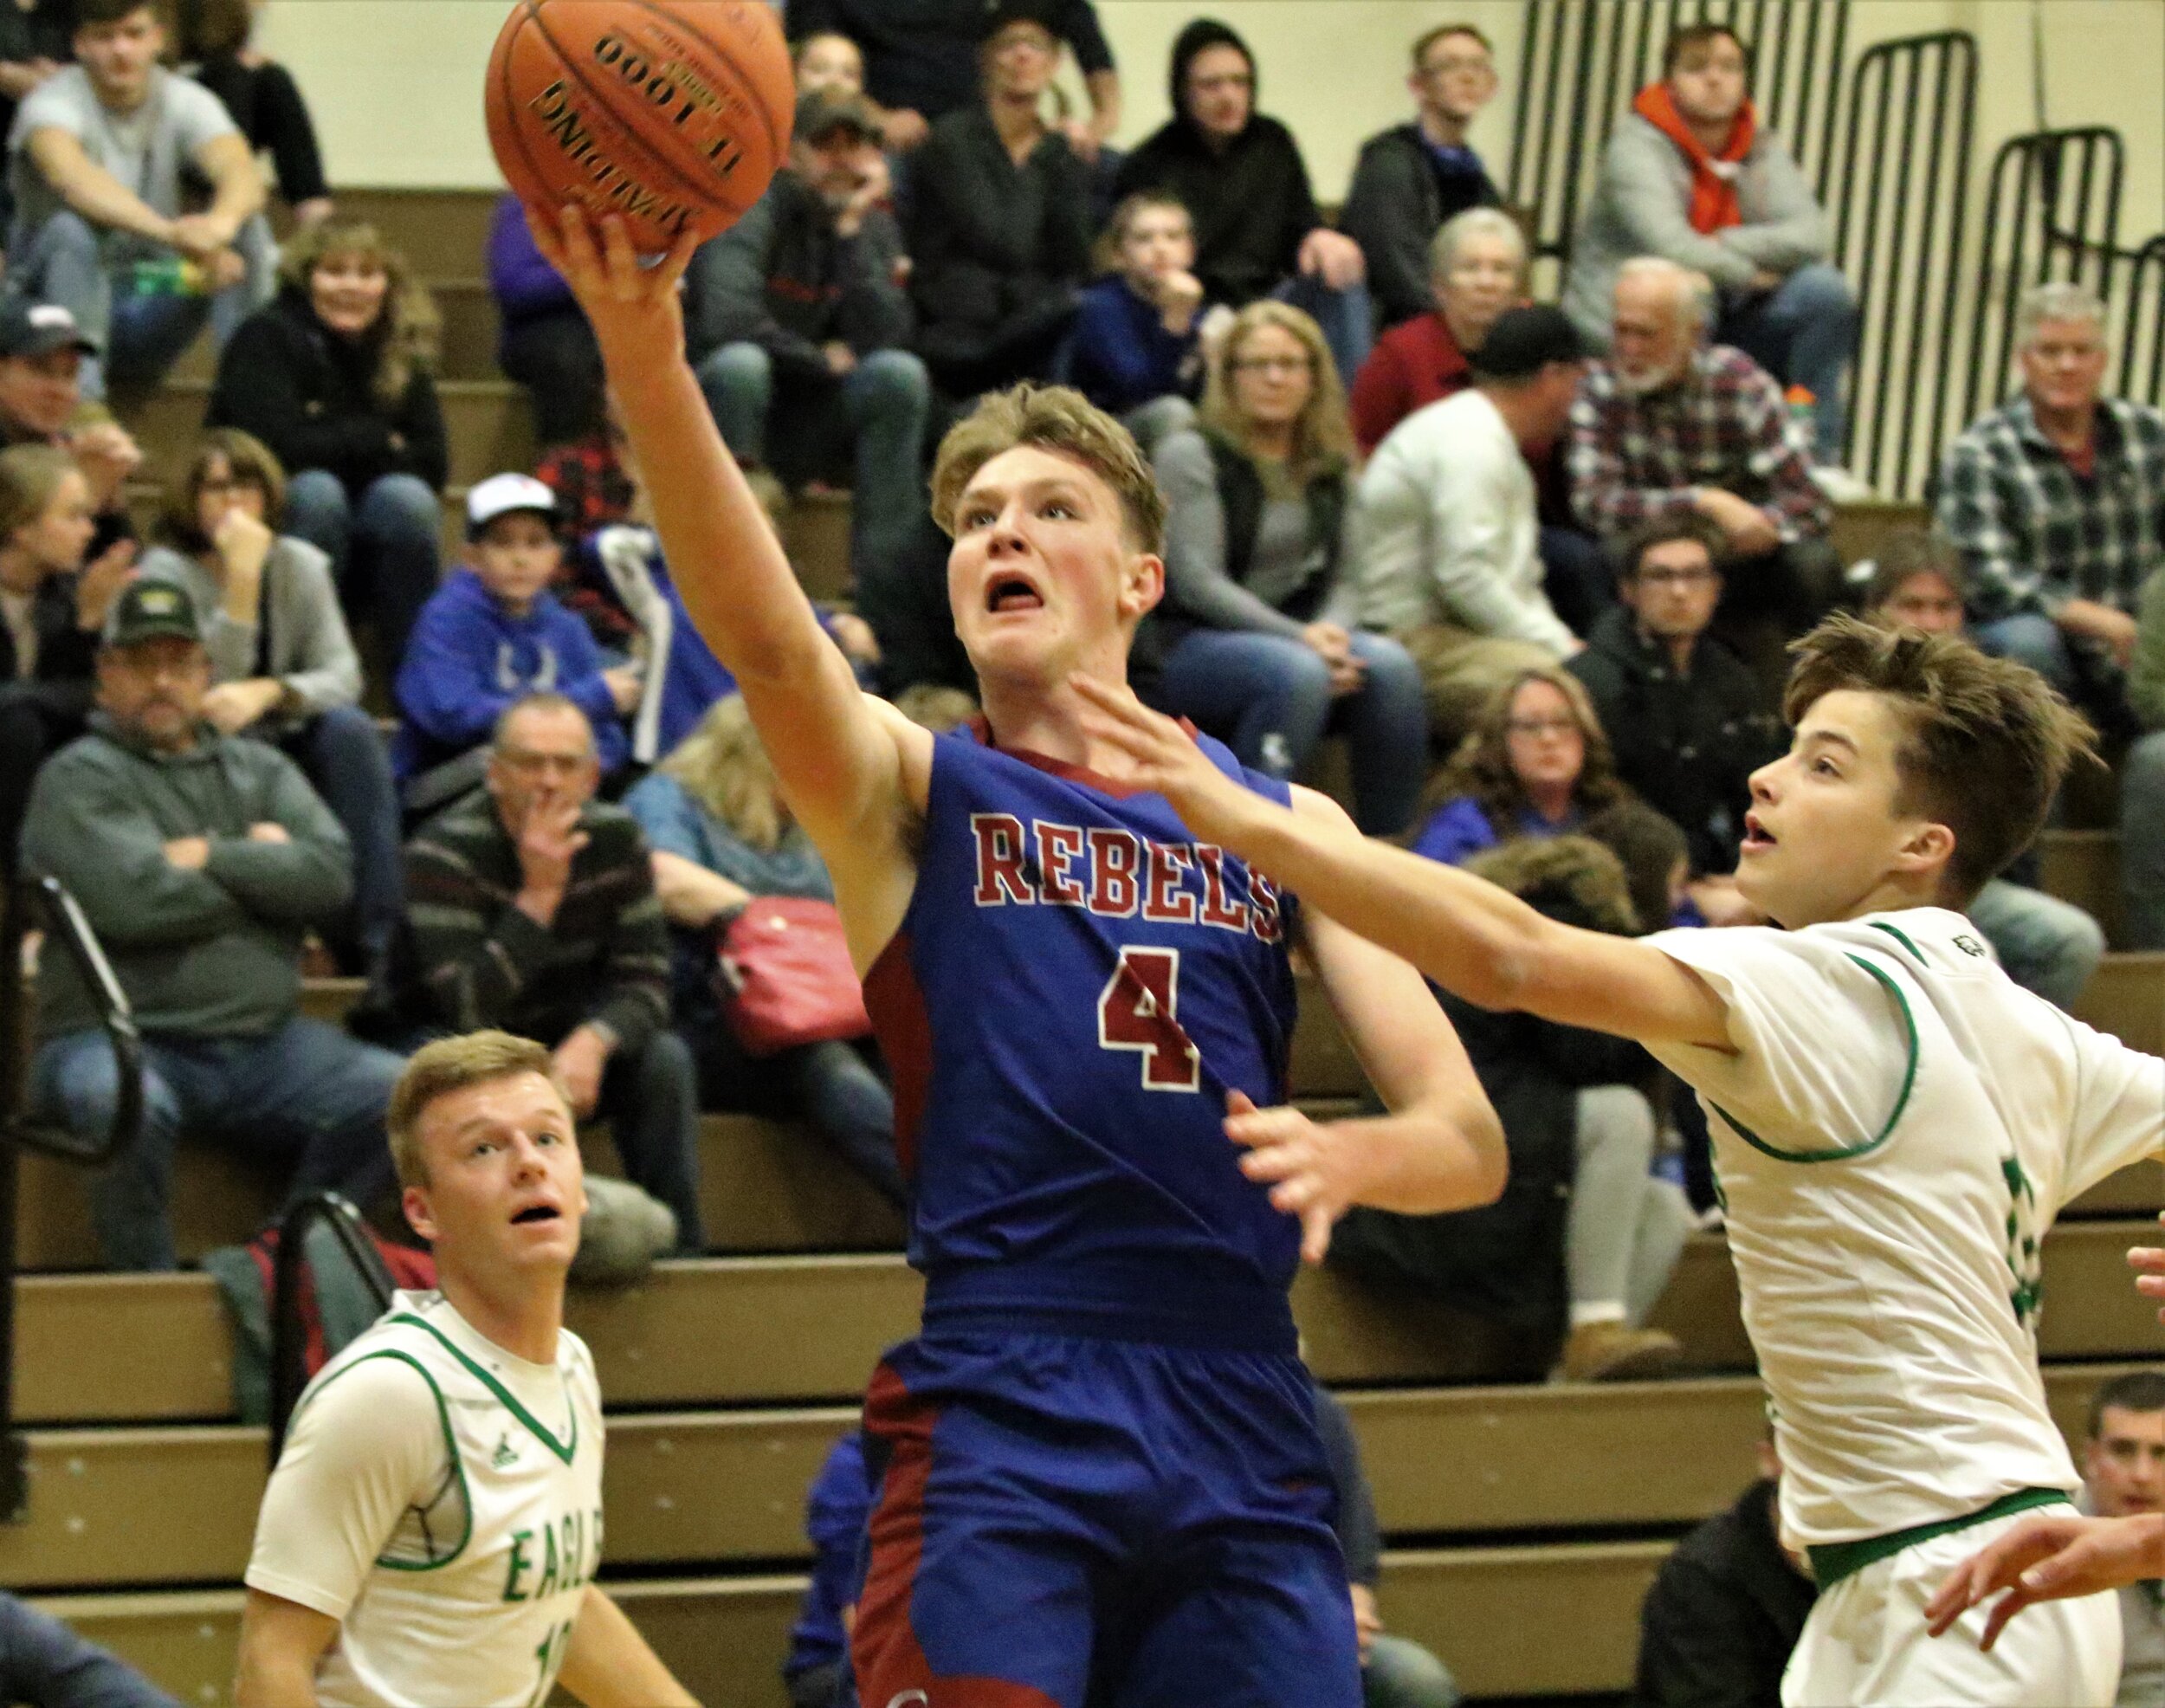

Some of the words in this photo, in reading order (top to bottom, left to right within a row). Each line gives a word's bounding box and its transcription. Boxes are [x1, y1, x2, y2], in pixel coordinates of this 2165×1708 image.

[527, 79, 703, 238] SPALDING
[970, 812, 1283, 945] REBELS
[1097, 944, 1200, 1093] 4
